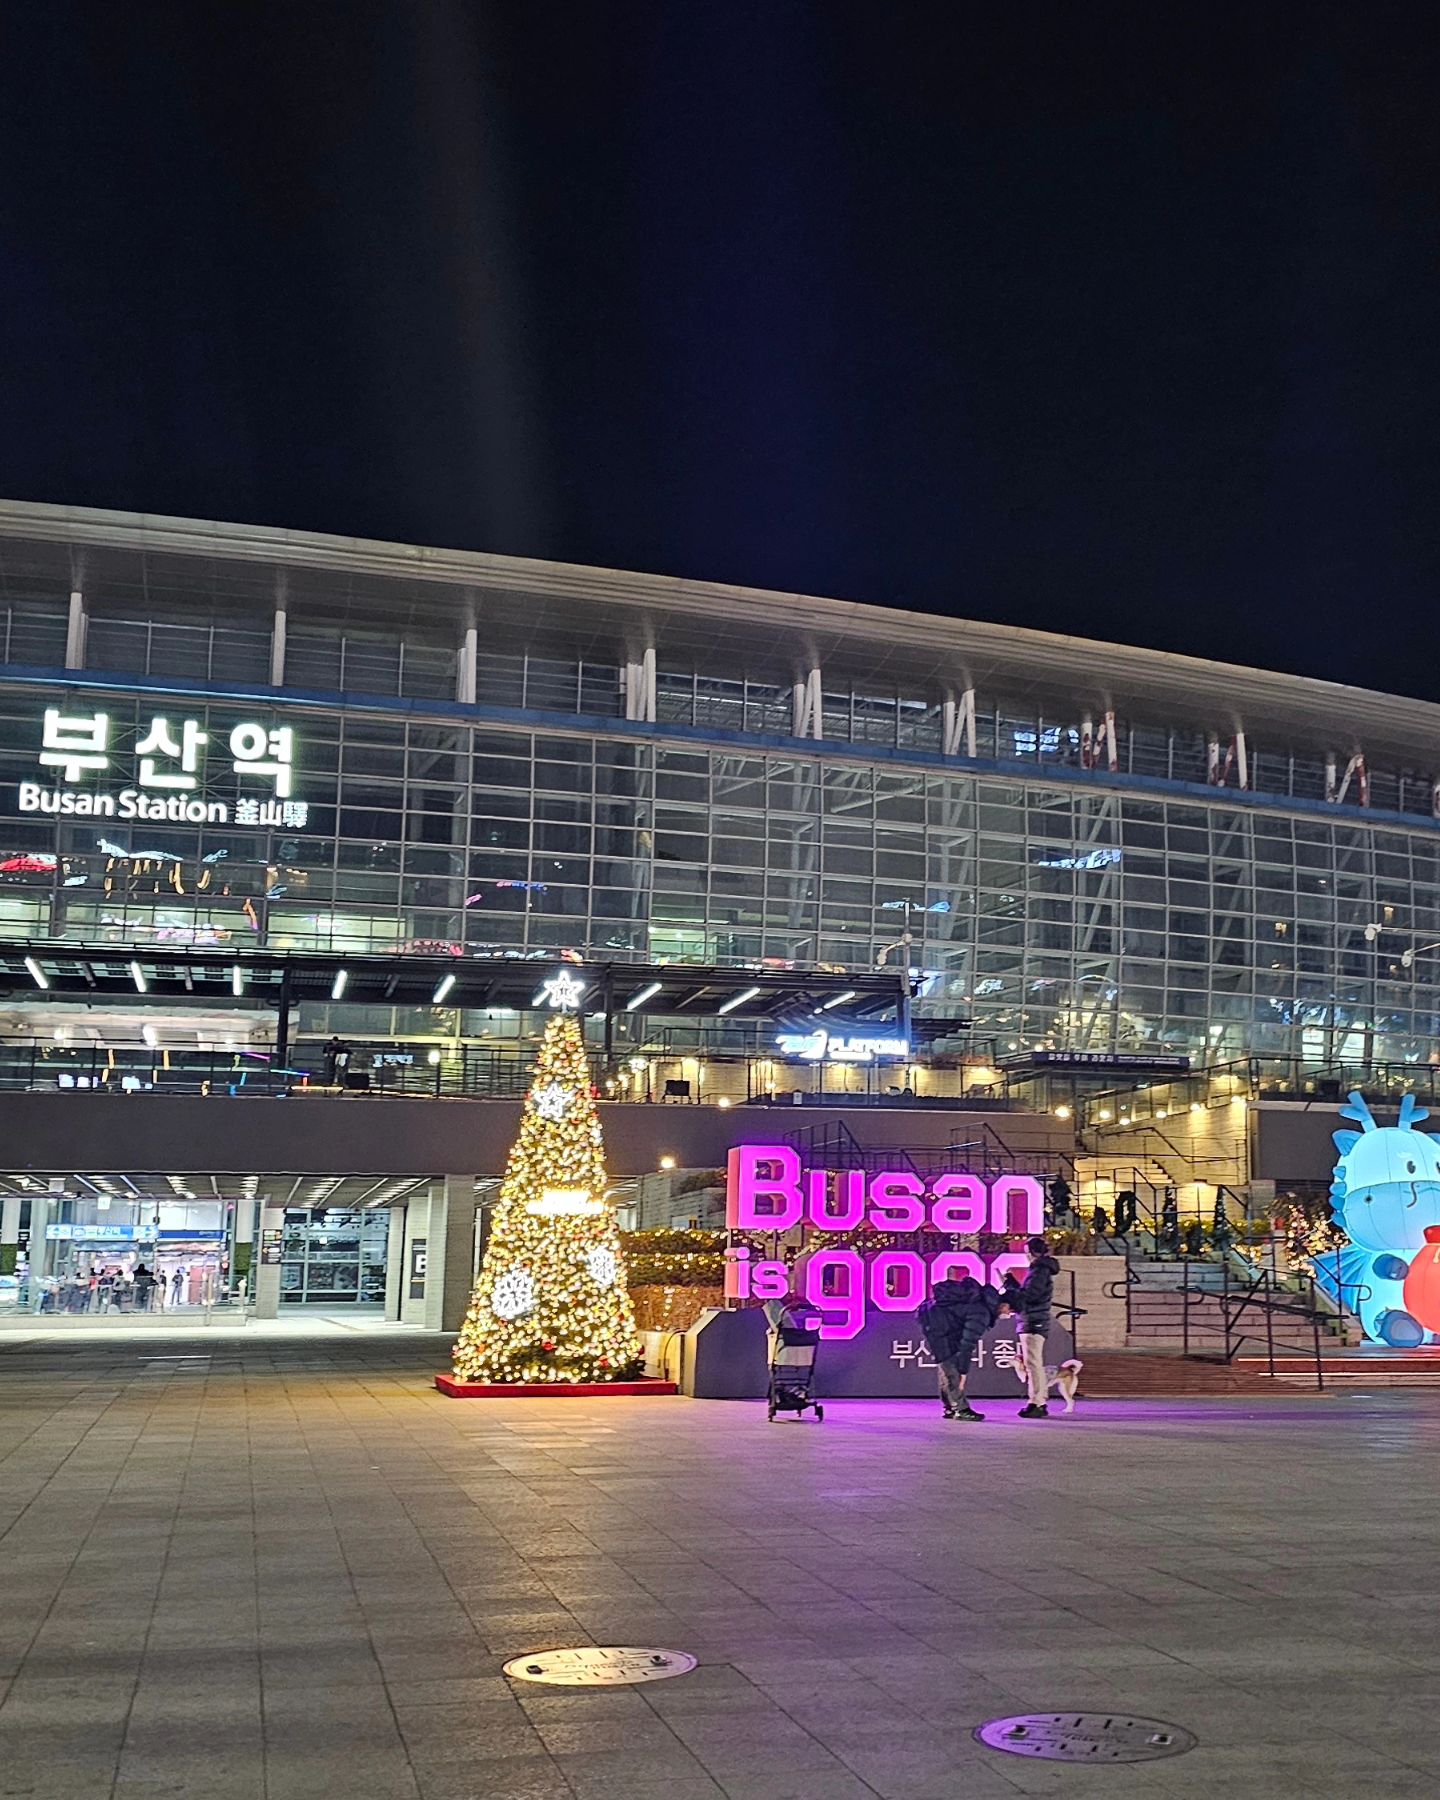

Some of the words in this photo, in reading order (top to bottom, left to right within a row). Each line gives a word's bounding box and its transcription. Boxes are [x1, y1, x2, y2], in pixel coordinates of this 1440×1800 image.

[39, 709, 294, 798] 부산역
[18, 781, 115, 817] Busan
[118, 789, 228, 824] Station
[234, 798, 309, 829] 釜山驛
[729, 1144, 1045, 1235] Busan
[730, 1246, 790, 1300] is
[805, 1249, 1034, 1341] goo
